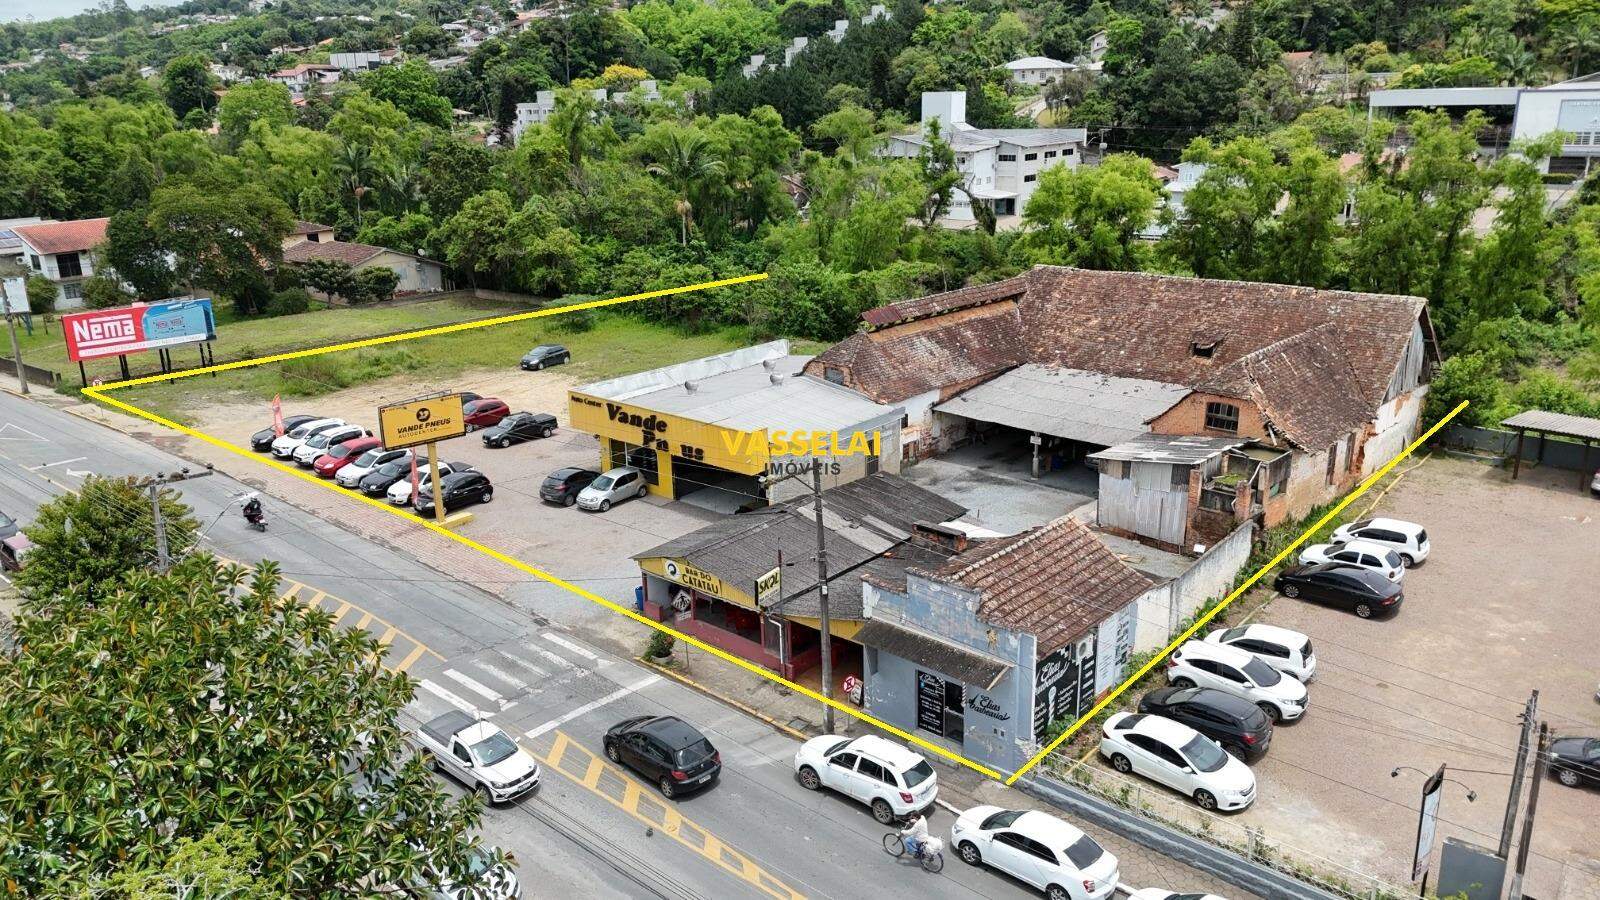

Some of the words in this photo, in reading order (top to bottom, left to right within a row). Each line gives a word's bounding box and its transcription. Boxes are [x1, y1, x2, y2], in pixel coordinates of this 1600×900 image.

[72, 319, 136, 342] Nema
[397, 424, 424, 434] VANDE
[425, 417, 451, 428] PNEUS
[606, 402, 668, 432] Vande
[682, 574, 718, 594] CATATAU
[700, 572, 712, 582] DO
[759, 572, 778, 594] SKOL
